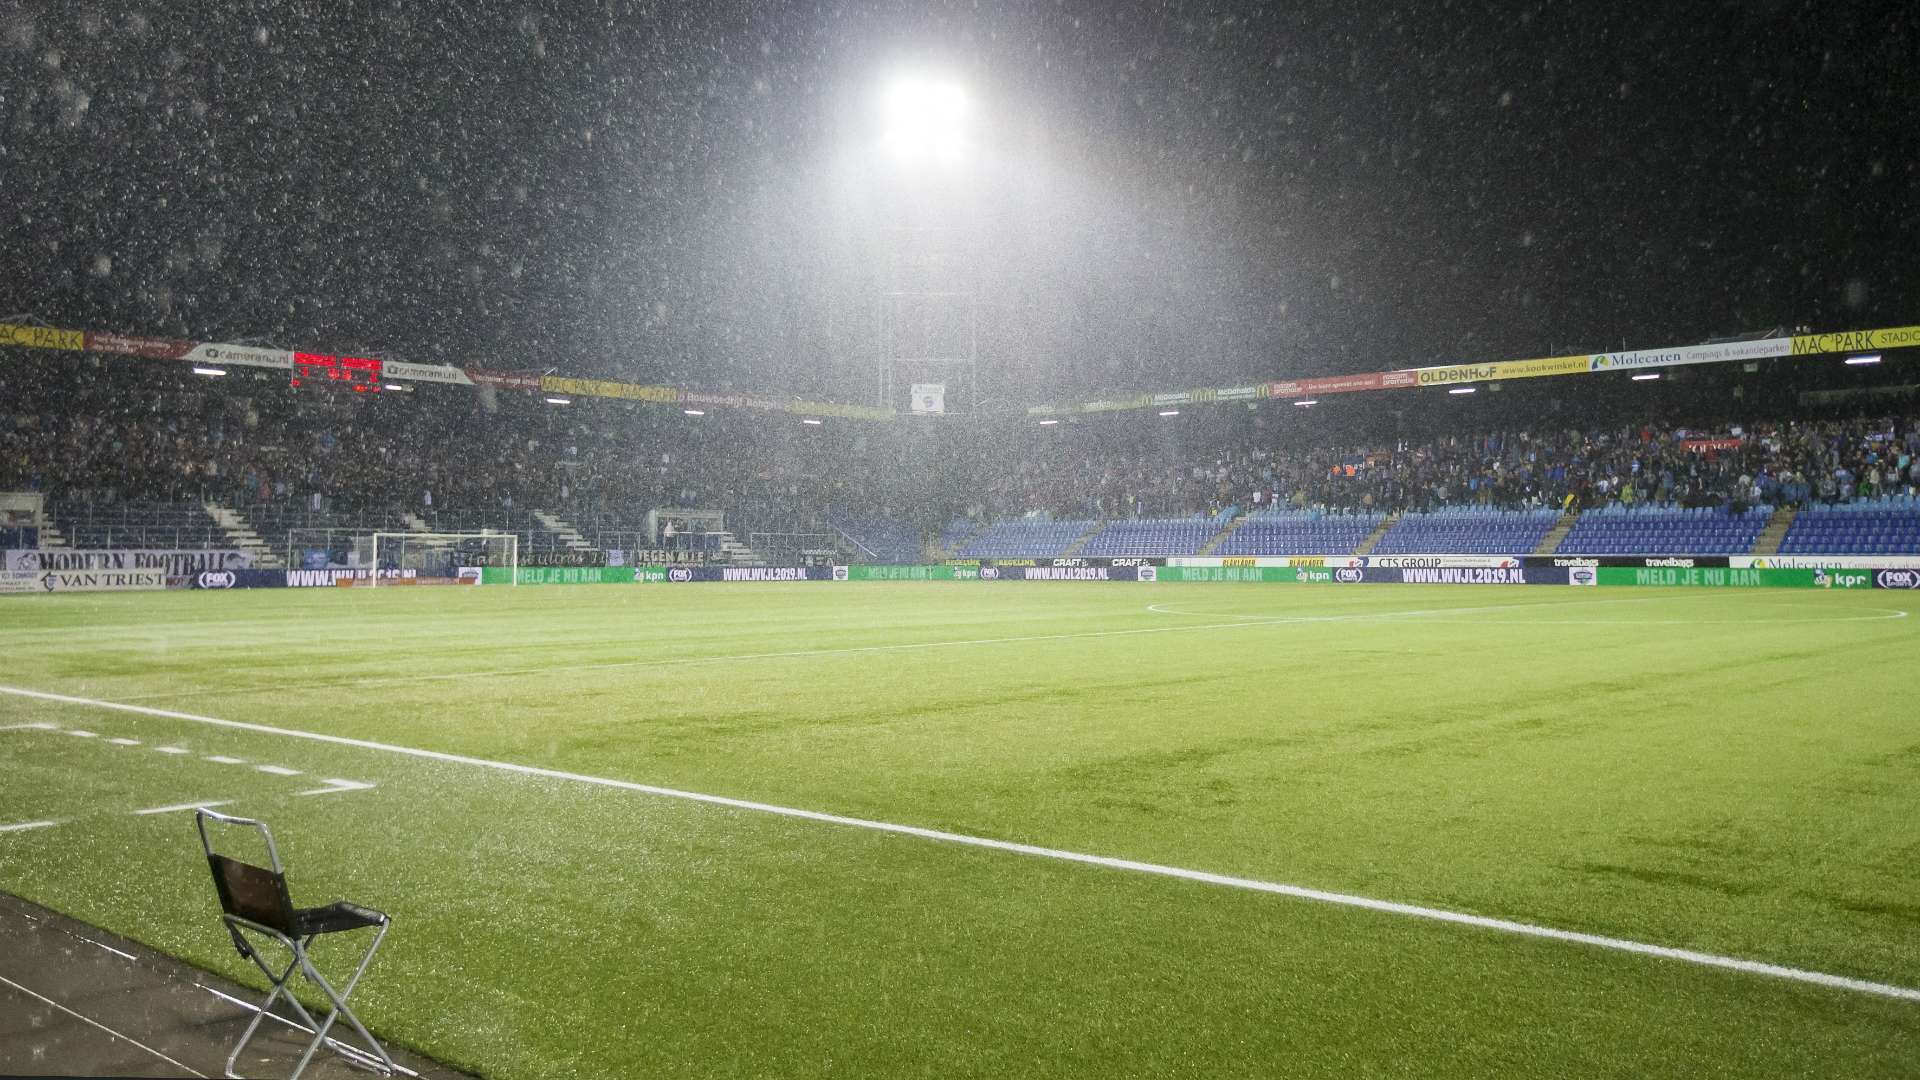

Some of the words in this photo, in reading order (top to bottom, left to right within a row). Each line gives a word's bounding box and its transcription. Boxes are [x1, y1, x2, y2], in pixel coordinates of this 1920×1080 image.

[1612, 352, 1681, 366] Molecaten
[638, 551, 676, 562] TEGEN
[678, 551, 704, 562] ALLE
[1053, 559, 1081, 567] CRAFT
[1112, 559, 1142, 567] CRAFT
[1379, 558, 1399, 567] CTS
[1402, 558, 1441, 567] GROUP
[1554, 558, 1599, 567] travelbags
[1645, 558, 1694, 567] travelbags
[206, 572, 228, 583] FOX
[646, 571, 664, 581] kpn
[1025, 568, 1109, 579] WWW.WVJL2019.NL
[1309, 571, 1329, 581] kpn
[1341, 569, 1357, 578] FOX
[1402, 569, 1526, 583] WWW.WVJL2019.NL
[1637, 569, 1676, 584] MELD
[1681, 569, 1699, 584] JE
[1704, 569, 1724, 584] NU
[1730, 569, 1760, 584] AAN
[1886, 572, 1911, 582] FOX
[60, 574, 98, 586] VAN
[102, 572, 163, 586] TRIEST
[1835, 573, 1866, 587] kpn
